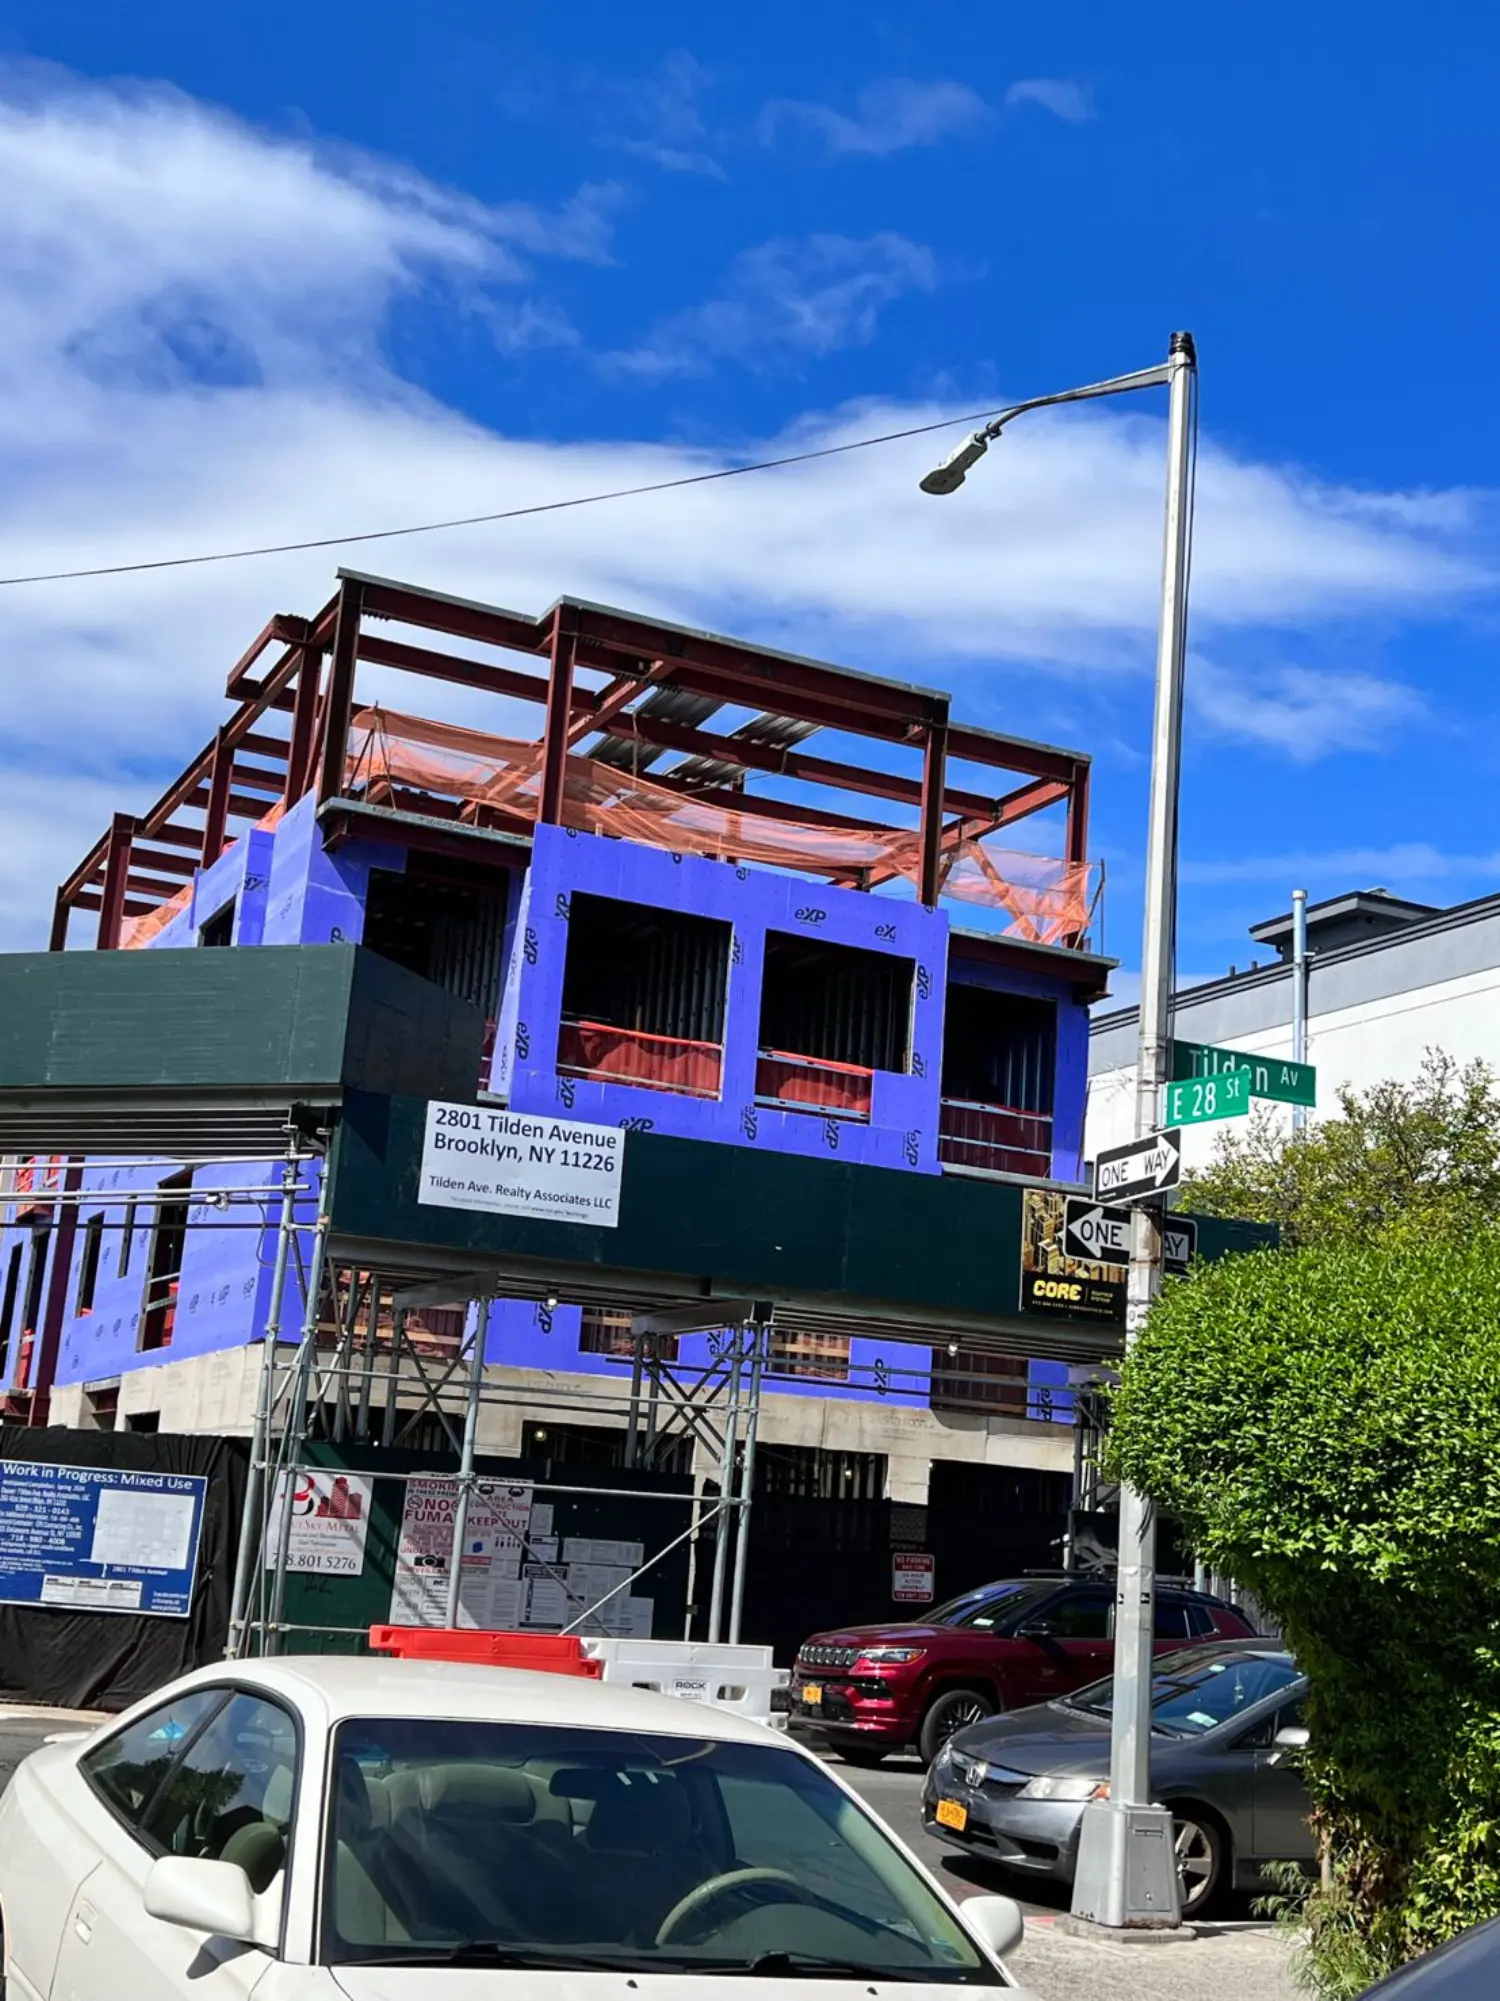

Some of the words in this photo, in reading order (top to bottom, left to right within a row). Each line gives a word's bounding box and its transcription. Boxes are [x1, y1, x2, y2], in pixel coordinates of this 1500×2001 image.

[794, 907, 826, 924] eXP
[874, 924, 896, 940] eX
[523, 927, 539, 966] eXP
[917, 965, 930, 1000] eXP
[515, 1022, 530, 1061] eXP
[1281, 1066, 1298, 1086] Av
[1173, 1088, 1183, 1120] E
[1192, 1082, 1216, 1115] 28
[1226, 1077, 1240, 1099] St
[435, 1108, 481, 1130] 2801
[487, 1115, 544, 1139] Tilden
[548, 1125, 616, 1149] Avenue
[434, 1132, 522, 1163] Brooklyn,
[529, 1145, 556, 1164] NY
[560, 1149, 615, 1172] 11226
[1102, 1161, 1129, 1188] ONE
[1144, 1148, 1171, 1176] WAY
[429, 1175, 465, 1190] Tilden
[467, 1181, 492, 1194] Ave.
[495, 1184, 532, 1201] Realty
[533, 1189, 591, 1207] Associates
[593, 1197, 612, 1210] LLC
[1081, 1219, 1122, 1247] ONE
[1164, 1233, 1185, 1257] AY
[1033, 1280, 1082, 1301] CORE
[3, 1463, 39, 1477] Work
[41, 1465, 54, 1478] in
[57, 1468, 118, 1484] Progress:
[120, 1473, 163, 1489] Mixed
[167, 1477, 193, 1491] Use
[409, 1480, 459, 1491] SMOKIN
[404, 1509, 454, 1524] FUMA
[424, 1498, 450, 1512] NO
[467, 1516, 499, 1527] KEEP
[272, 1552, 356, 1570] 78.801.5276
[675, 1681, 706, 1690] ROCK
